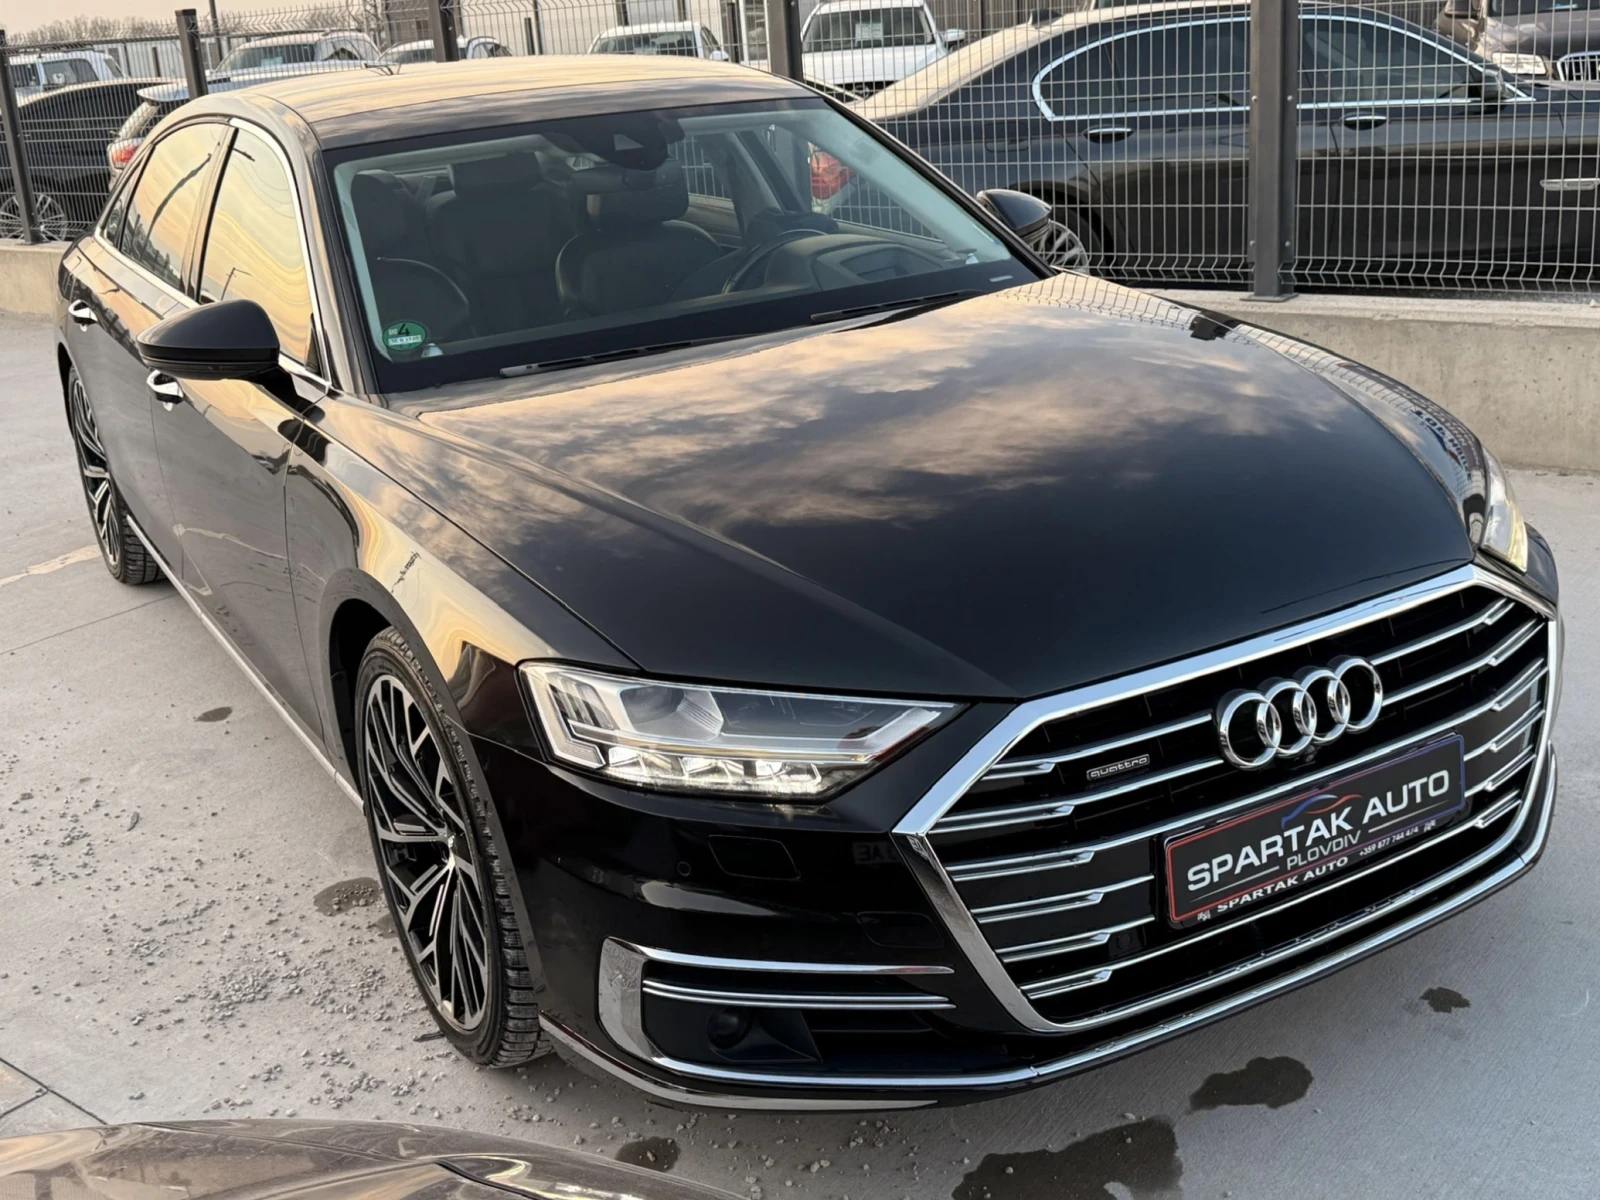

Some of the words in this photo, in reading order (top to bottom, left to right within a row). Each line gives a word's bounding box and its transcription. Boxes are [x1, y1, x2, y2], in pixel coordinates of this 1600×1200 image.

[397, 323, 410, 336] 4
[1090, 757, 1147, 777] quattro
[1187, 806, 1353, 891] SPARTAK
[1362, 769, 1449, 824] AUTO
[1286, 830, 1361, 870] PLOVDIV
[1217, 876, 1298, 912] SPARTAK
[1303, 856, 1349, 881] AUTO
